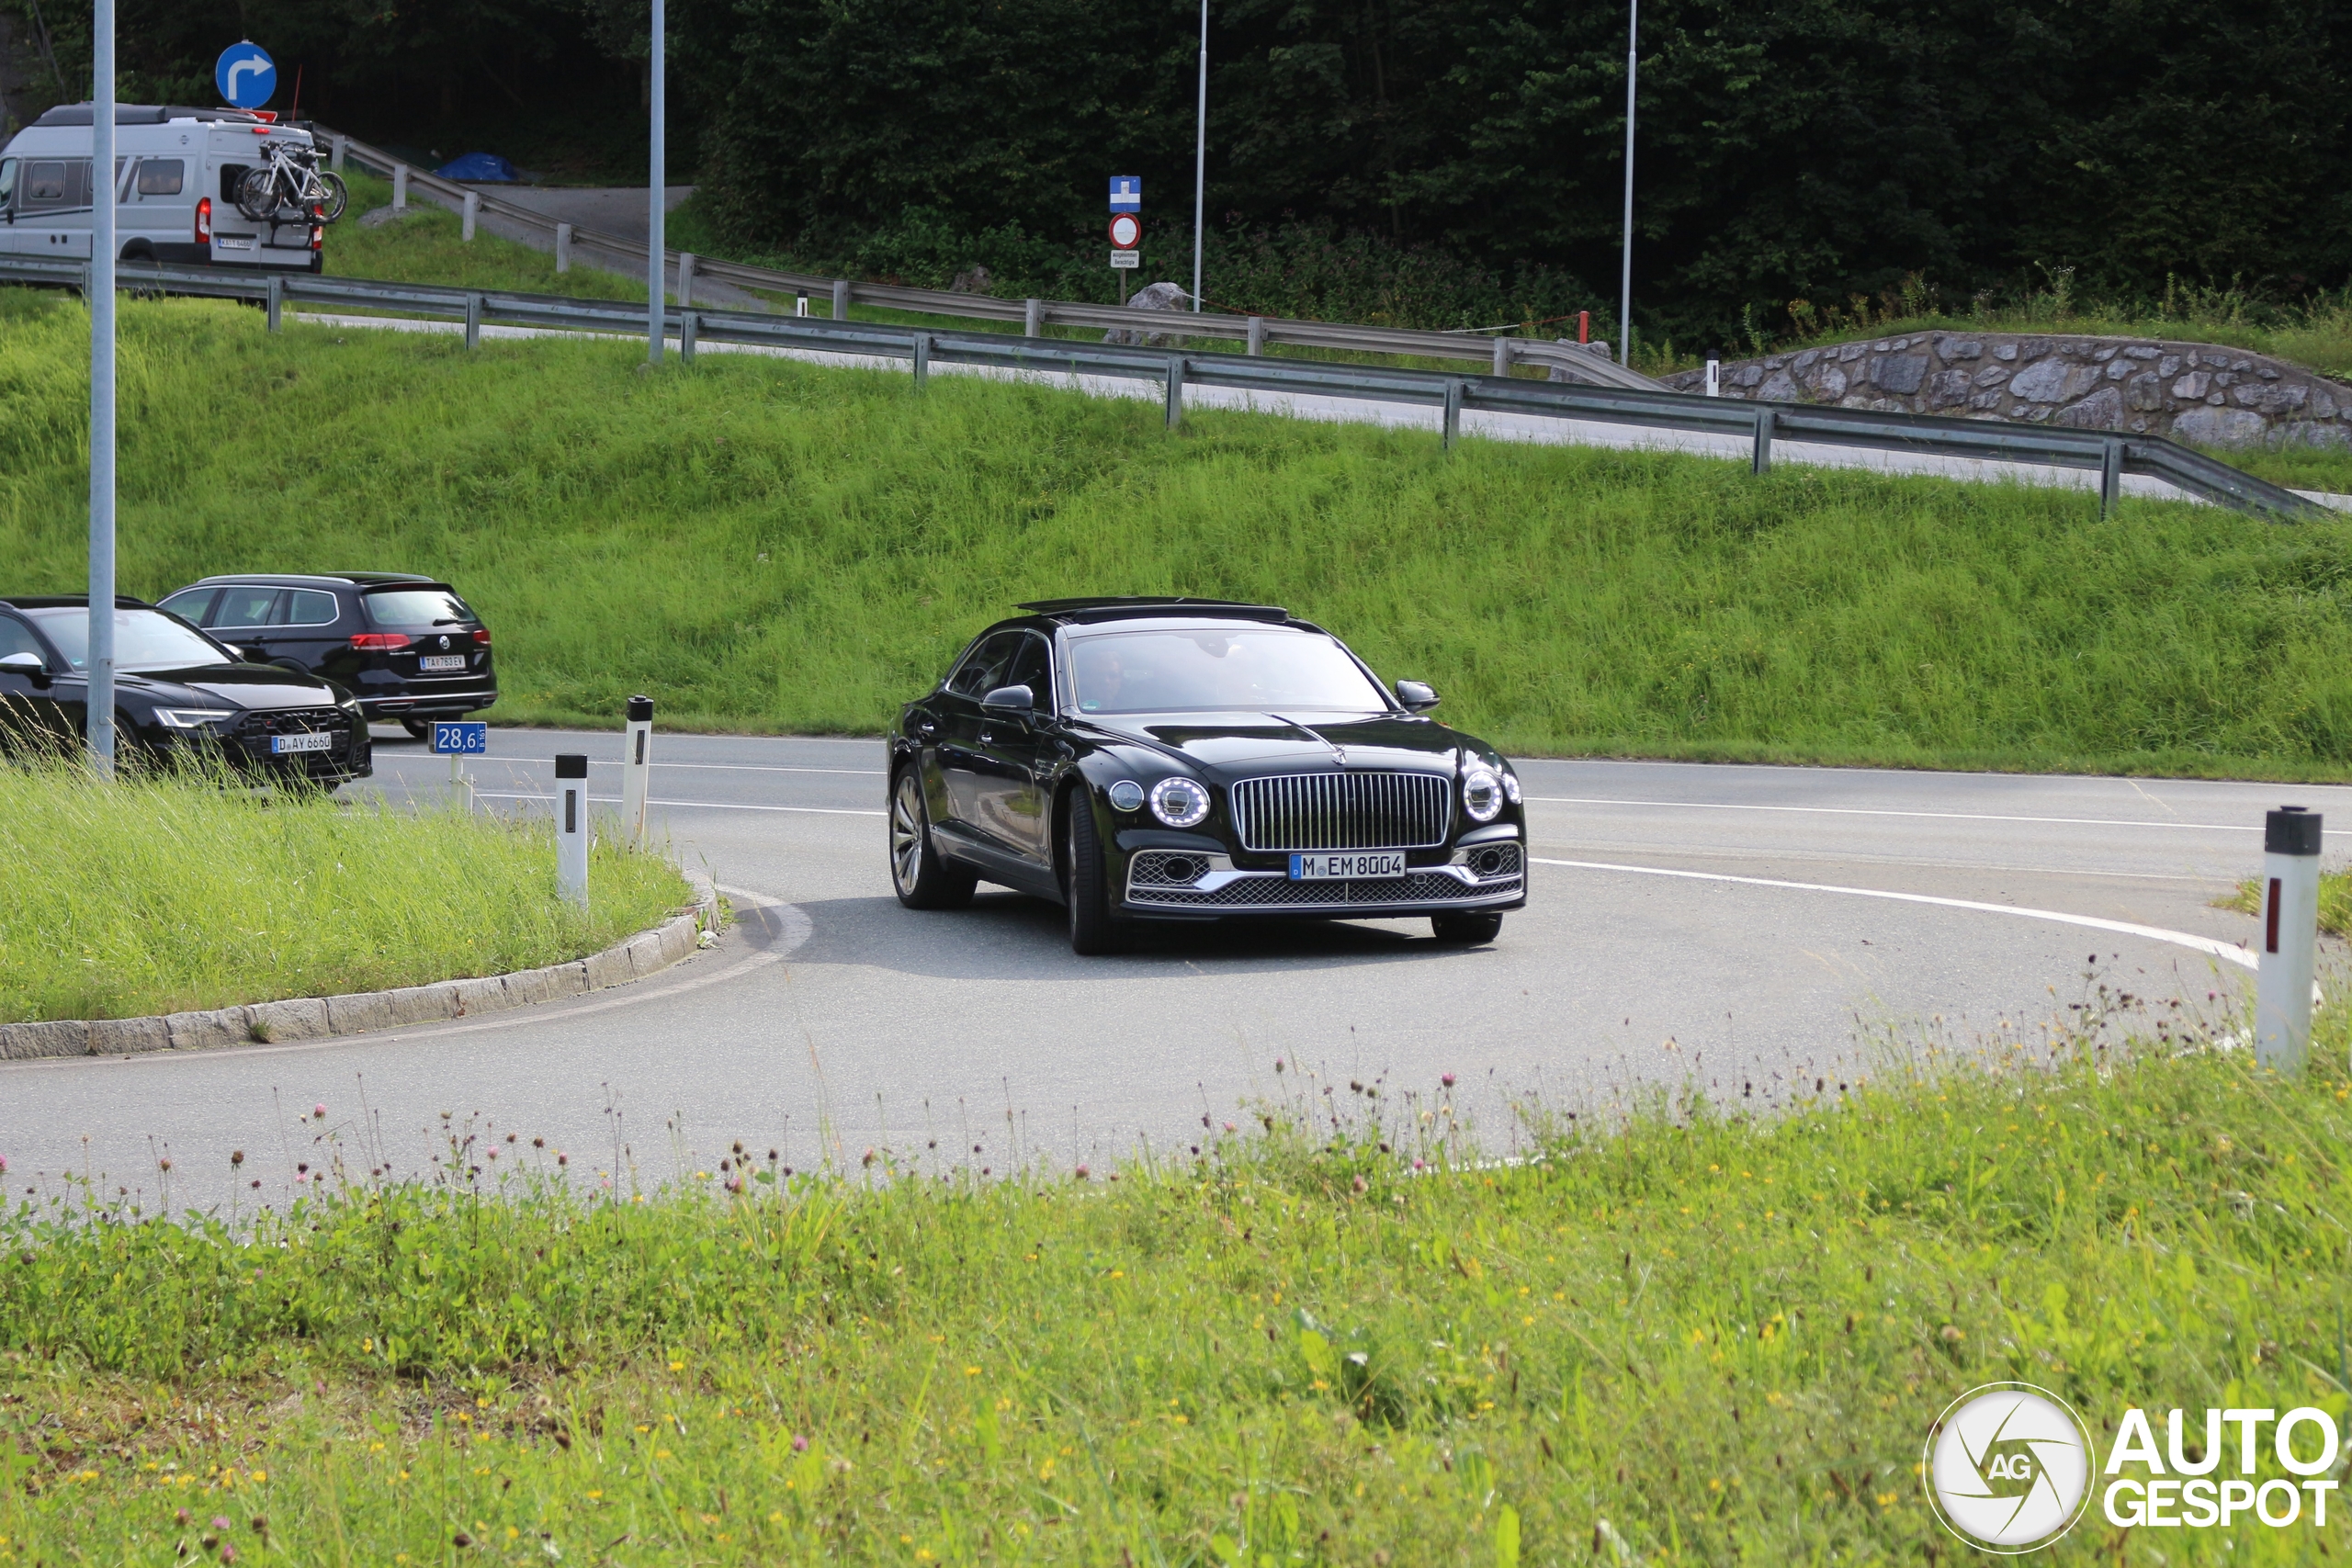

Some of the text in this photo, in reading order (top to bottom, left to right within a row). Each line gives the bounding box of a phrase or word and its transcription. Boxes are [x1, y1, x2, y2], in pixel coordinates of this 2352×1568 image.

[279, 739, 286, 750] D
[292, 738, 305, 750] AY
[438, 728, 476, 751] 28,6
[1303, 855, 1402, 875] M EM 8004
